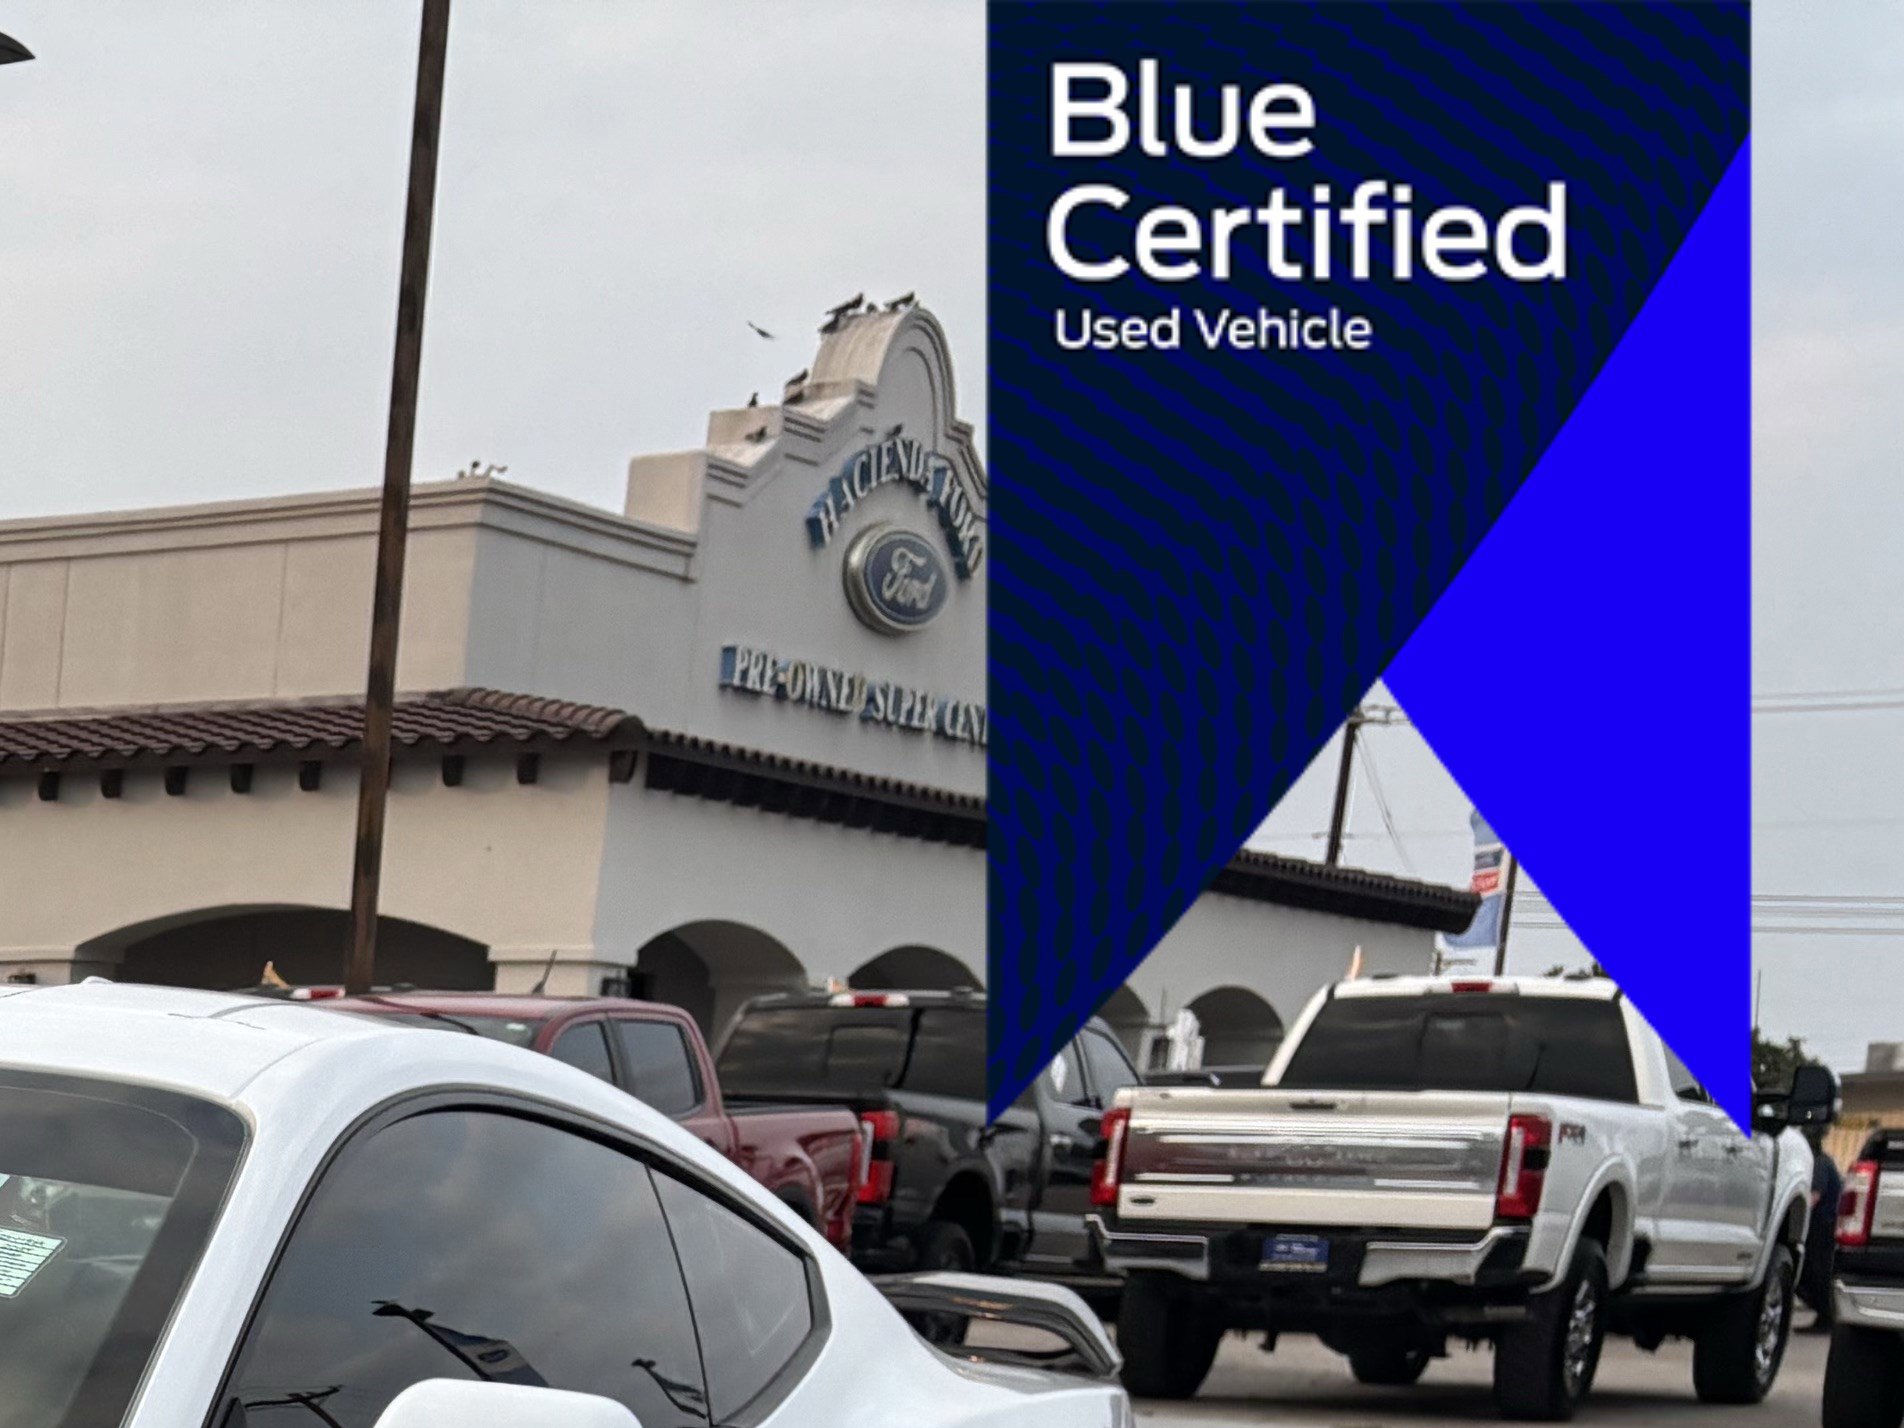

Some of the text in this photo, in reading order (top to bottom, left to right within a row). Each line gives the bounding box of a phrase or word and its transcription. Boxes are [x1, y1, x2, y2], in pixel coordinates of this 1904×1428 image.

[814, 437, 939, 544] HACIENDA
[881, 546, 938, 610] Ford
[728, 644, 867, 712] PRE-OWNED
[871, 679, 939, 732] SUPER
